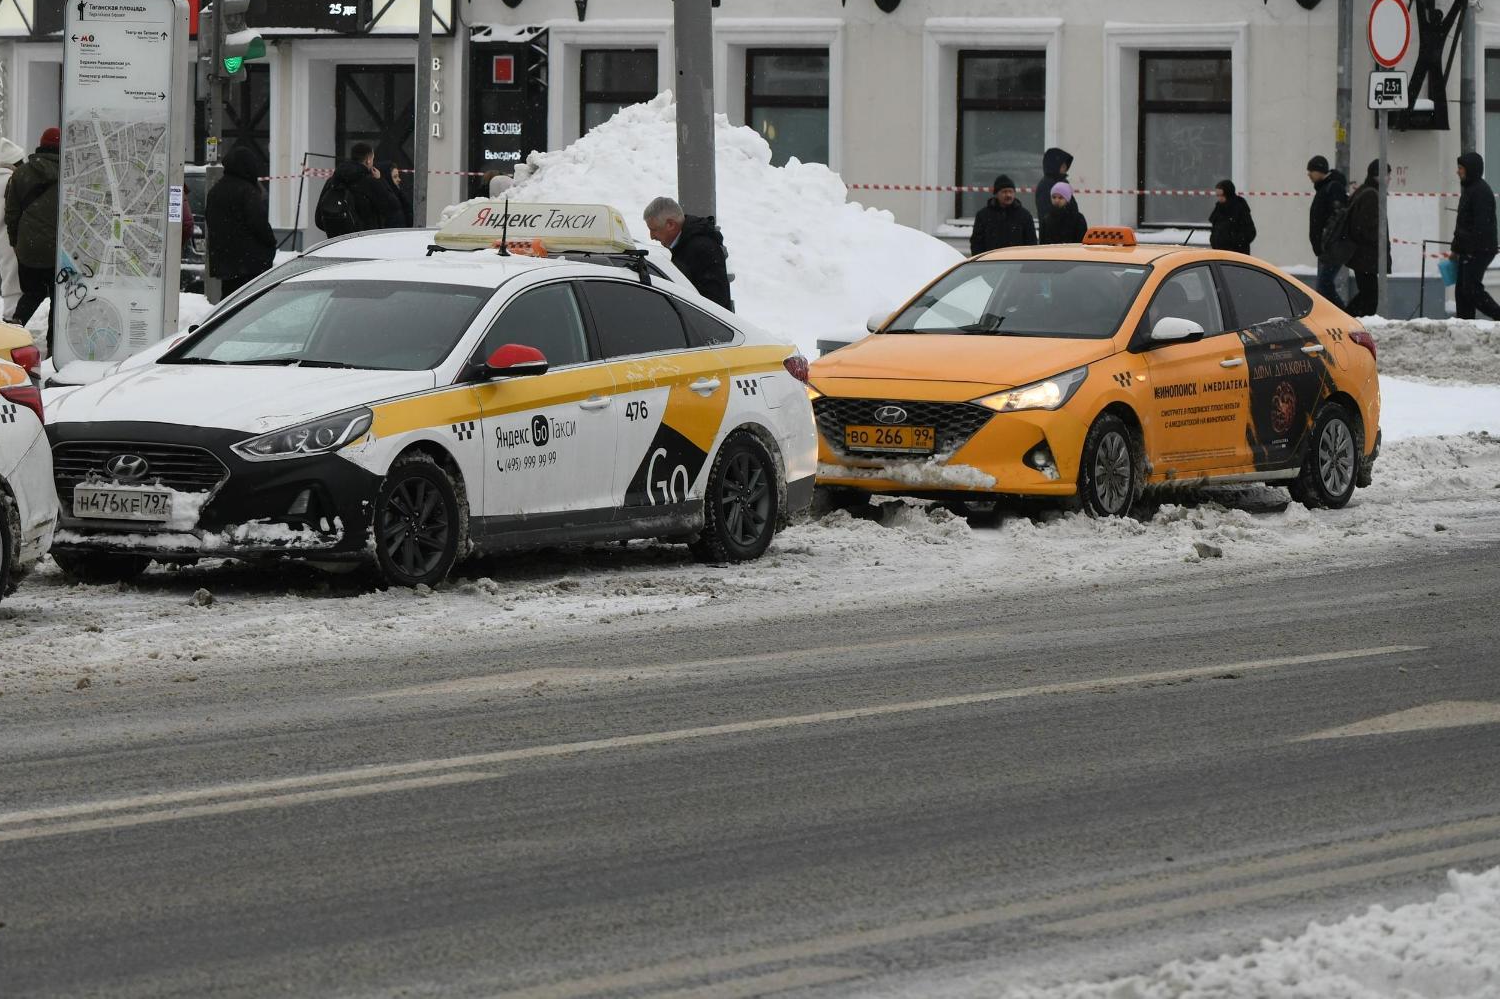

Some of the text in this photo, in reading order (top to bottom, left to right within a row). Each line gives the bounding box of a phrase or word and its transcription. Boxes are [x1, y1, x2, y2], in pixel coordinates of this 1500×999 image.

[329, 3, 342, 14] 25
[432, 58, 441, 137] ВХОД
[472, 208, 596, 229] Яндекс Такси
[625, 400, 648, 421] 476
[496, 418, 576, 448] Яндекс Go Такси
[851, 429, 929, 445] ВО 266 99
[505, 451, 556, 473] (495) 999 99 99
[144, 494, 168, 509] 797
